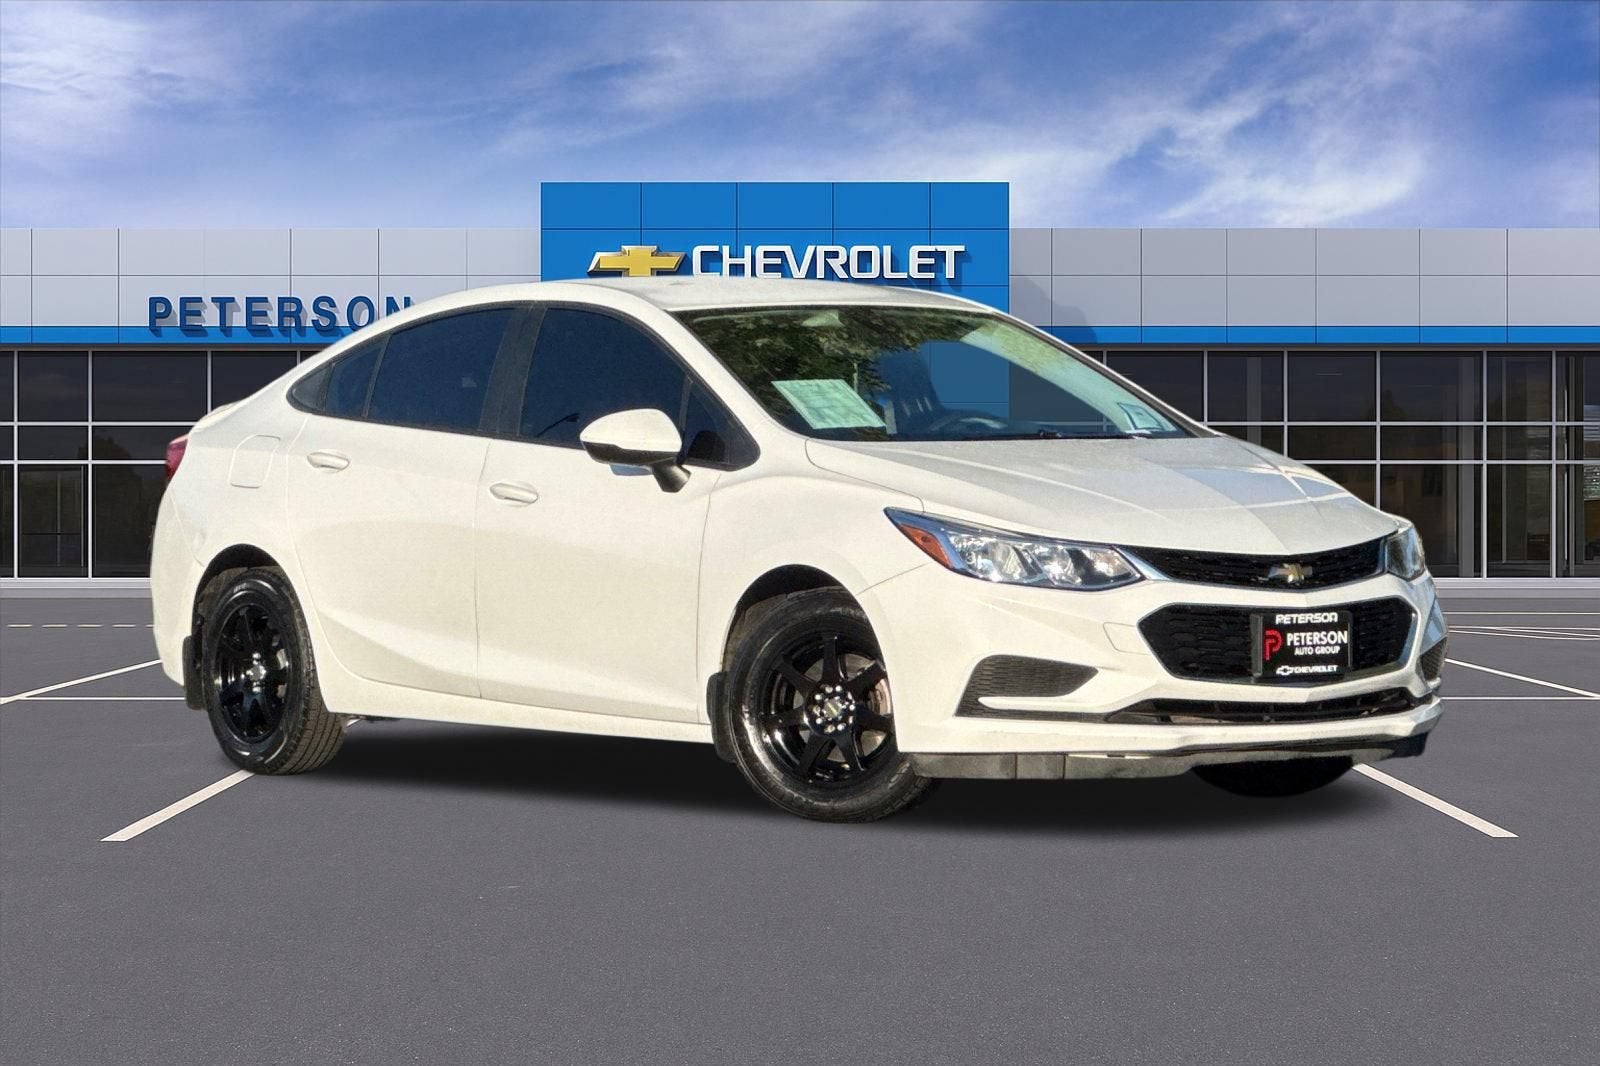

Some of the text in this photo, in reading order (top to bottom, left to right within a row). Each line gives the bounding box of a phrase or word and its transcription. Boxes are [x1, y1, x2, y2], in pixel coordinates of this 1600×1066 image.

[692, 245, 965, 279] CHEVROLET
[1275, 612, 1339, 625] PETERSON
[1286, 630, 1348, 646] PETERSON
[1294, 646, 1341, 656] AUTO GROUP
[1294, 664, 1338, 674] CHEVROLET
